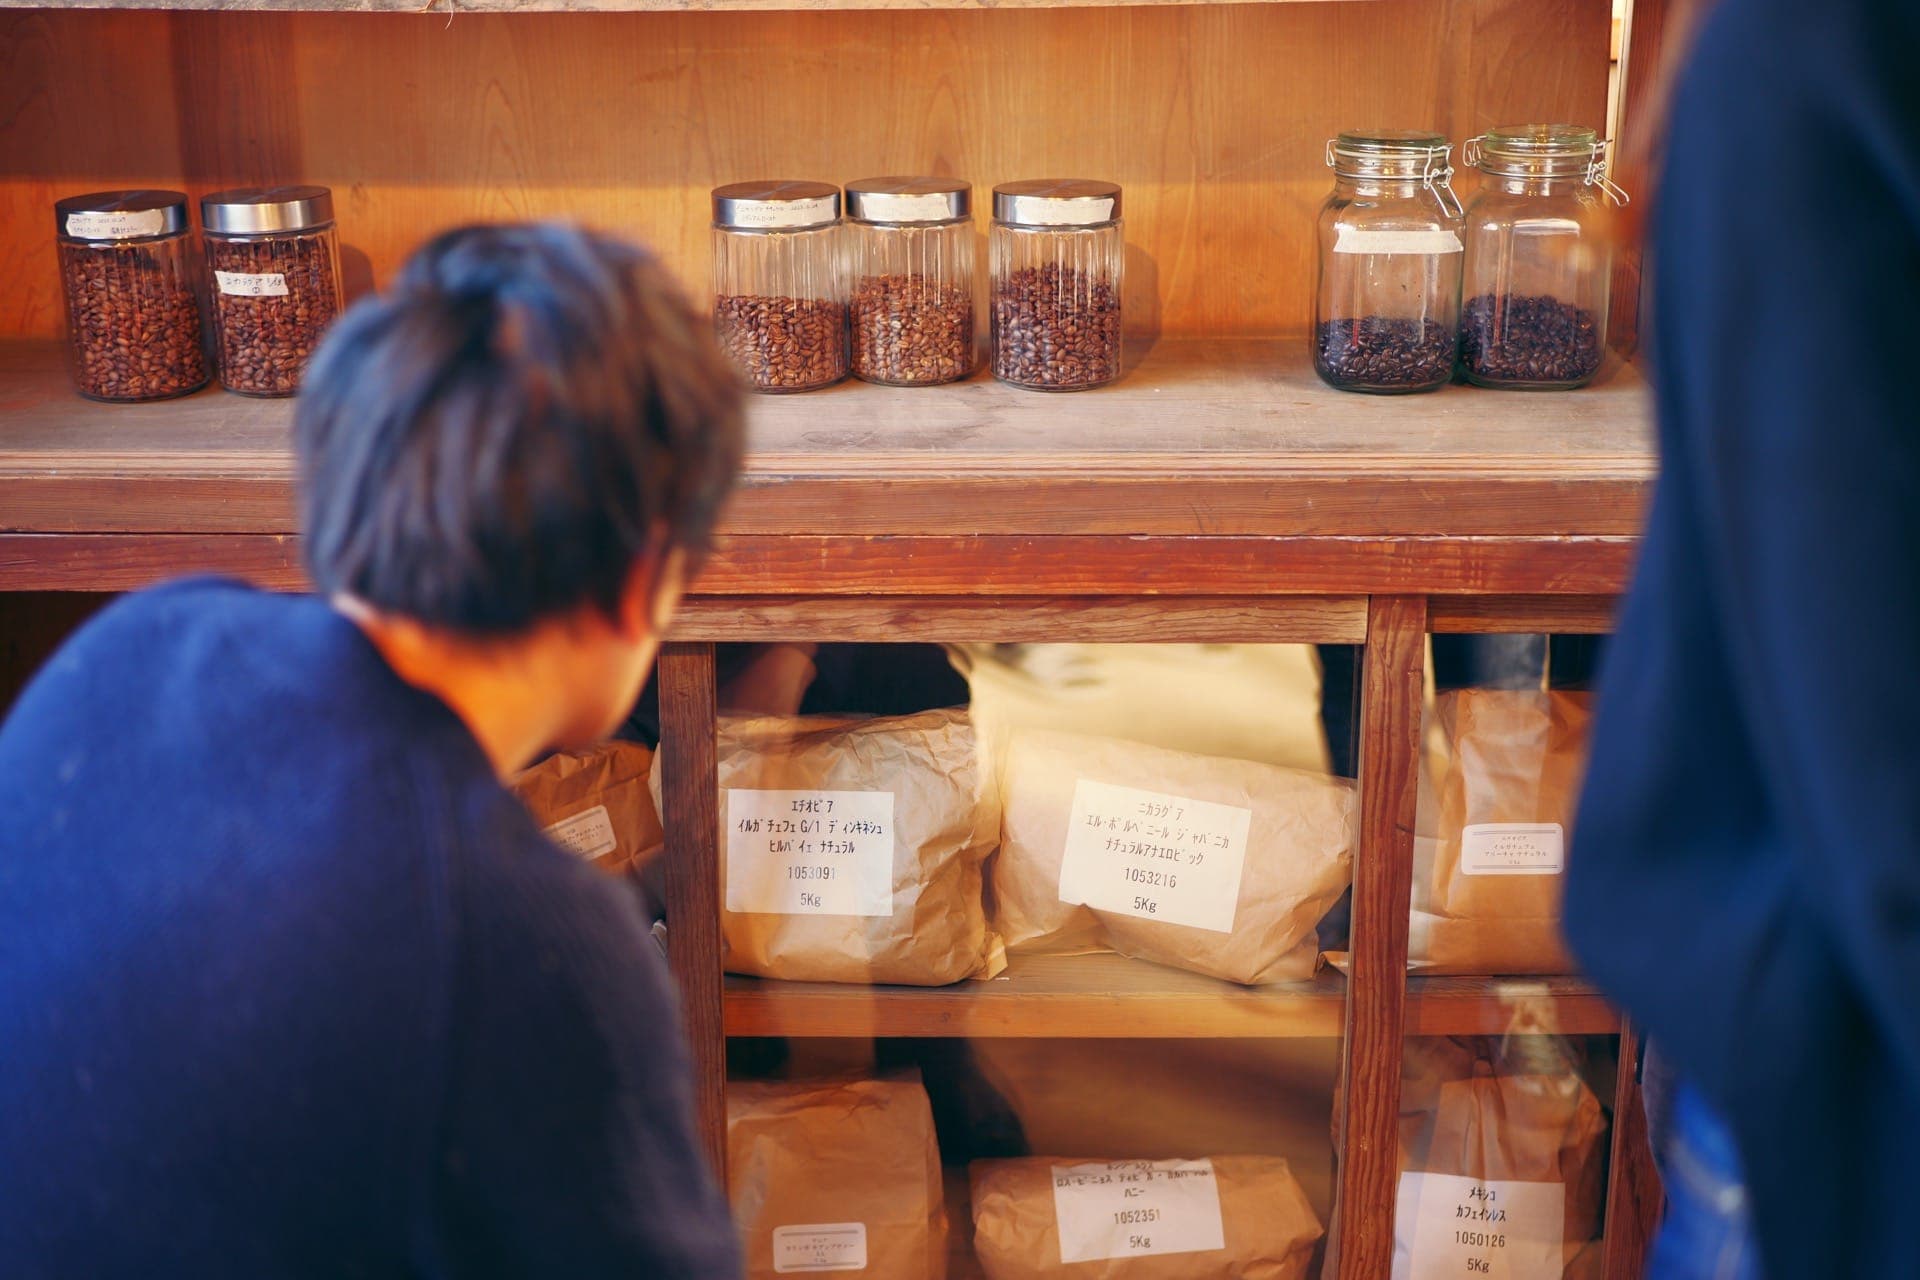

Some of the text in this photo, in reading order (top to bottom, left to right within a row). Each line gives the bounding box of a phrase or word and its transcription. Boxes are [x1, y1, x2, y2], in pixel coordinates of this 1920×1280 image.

[1138, 802, 1184, 821] ニカラグア
[738, 819, 883, 835] イルガチェフェ G/1 ディンキネシュ
[820, 841, 855, 854] ナチュラル
[788, 866, 835, 880] 1053091
[1124, 867, 1177, 888] 1053216
[800, 893, 821, 907] 5Kg
[1133, 896, 1157, 913] 5Kg
[1124, 1188, 1145, 1198] ハニー
[1469, 1186, 1496, 1201] メキシコ
[1114, 1208, 1161, 1225] 1052351
[1456, 1205, 1506, 1222] カフェインレス
[1129, 1235, 1152, 1249] 5Kg
[1455, 1231, 1505, 1248] 1050126
[1467, 1258, 1490, 1273] 5Kg
